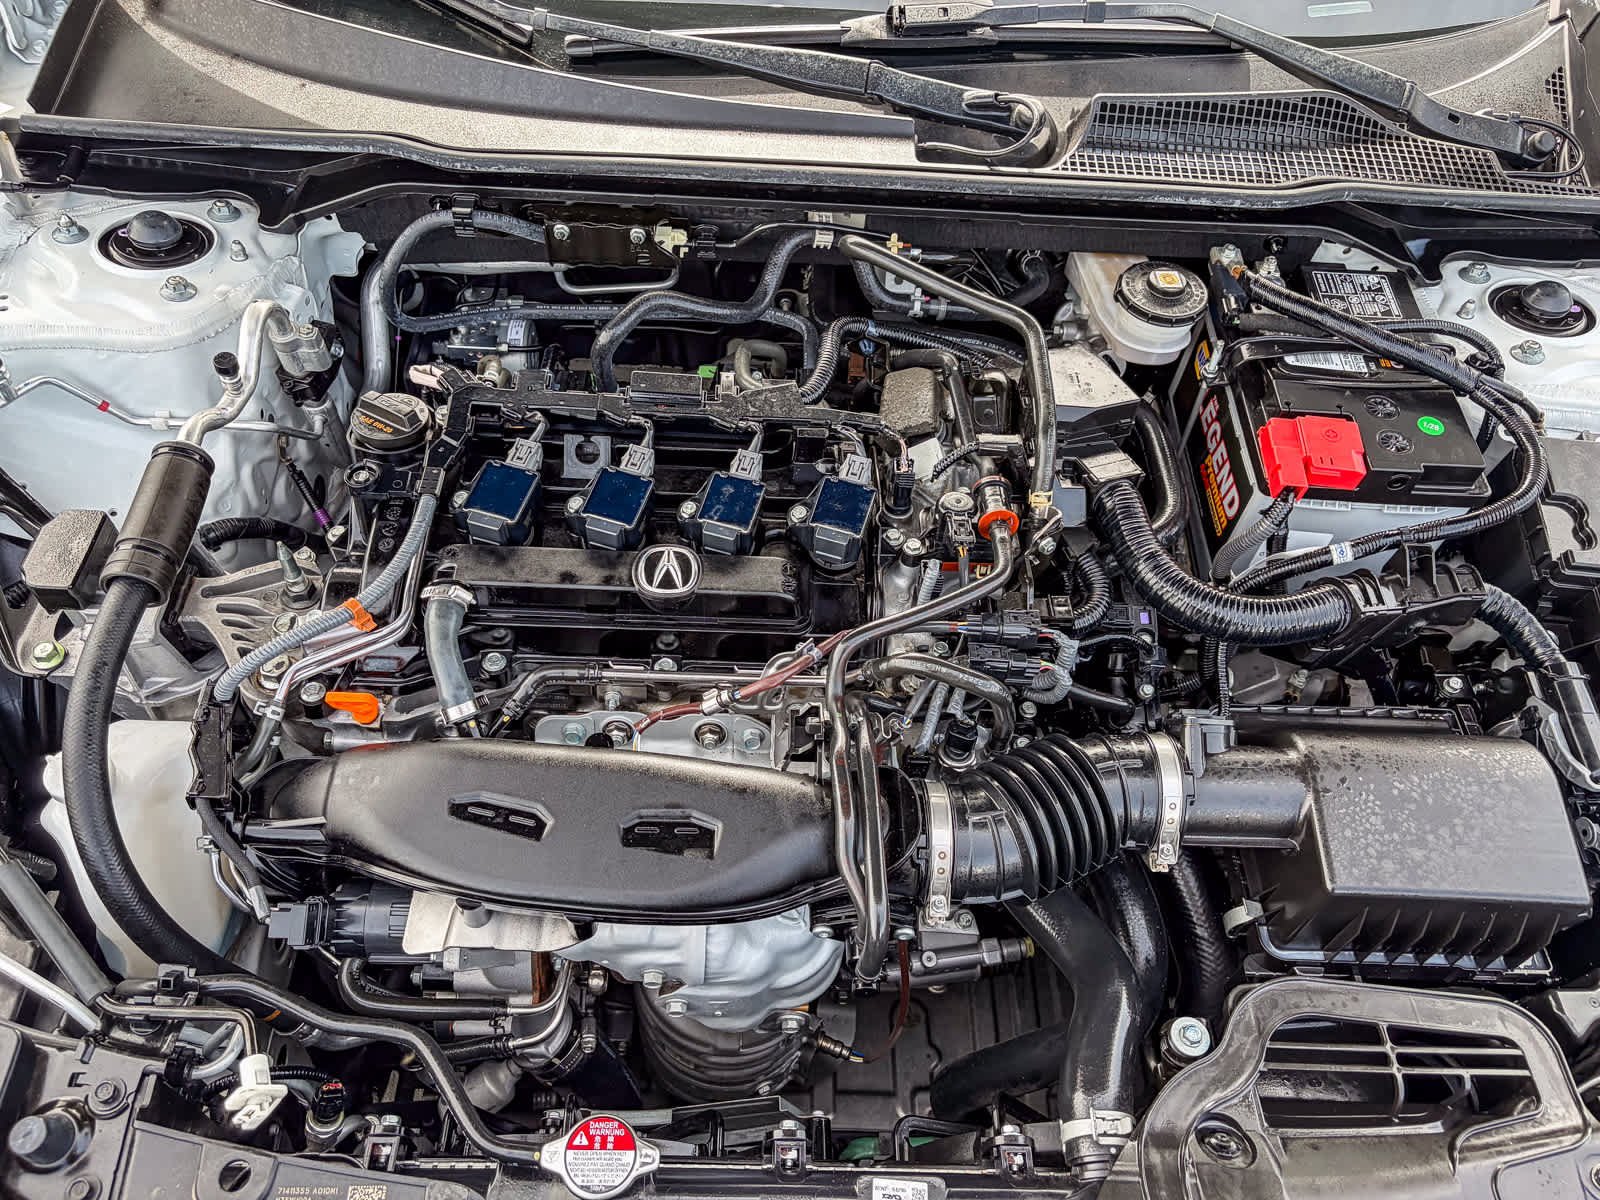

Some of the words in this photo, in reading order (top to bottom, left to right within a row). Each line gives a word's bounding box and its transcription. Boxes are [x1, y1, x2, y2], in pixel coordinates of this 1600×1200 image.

[1204, 454, 1228, 530] Premium
[589, 1121, 619, 1129] DANGER
[589, 1128, 625, 1136] WARNUNG
